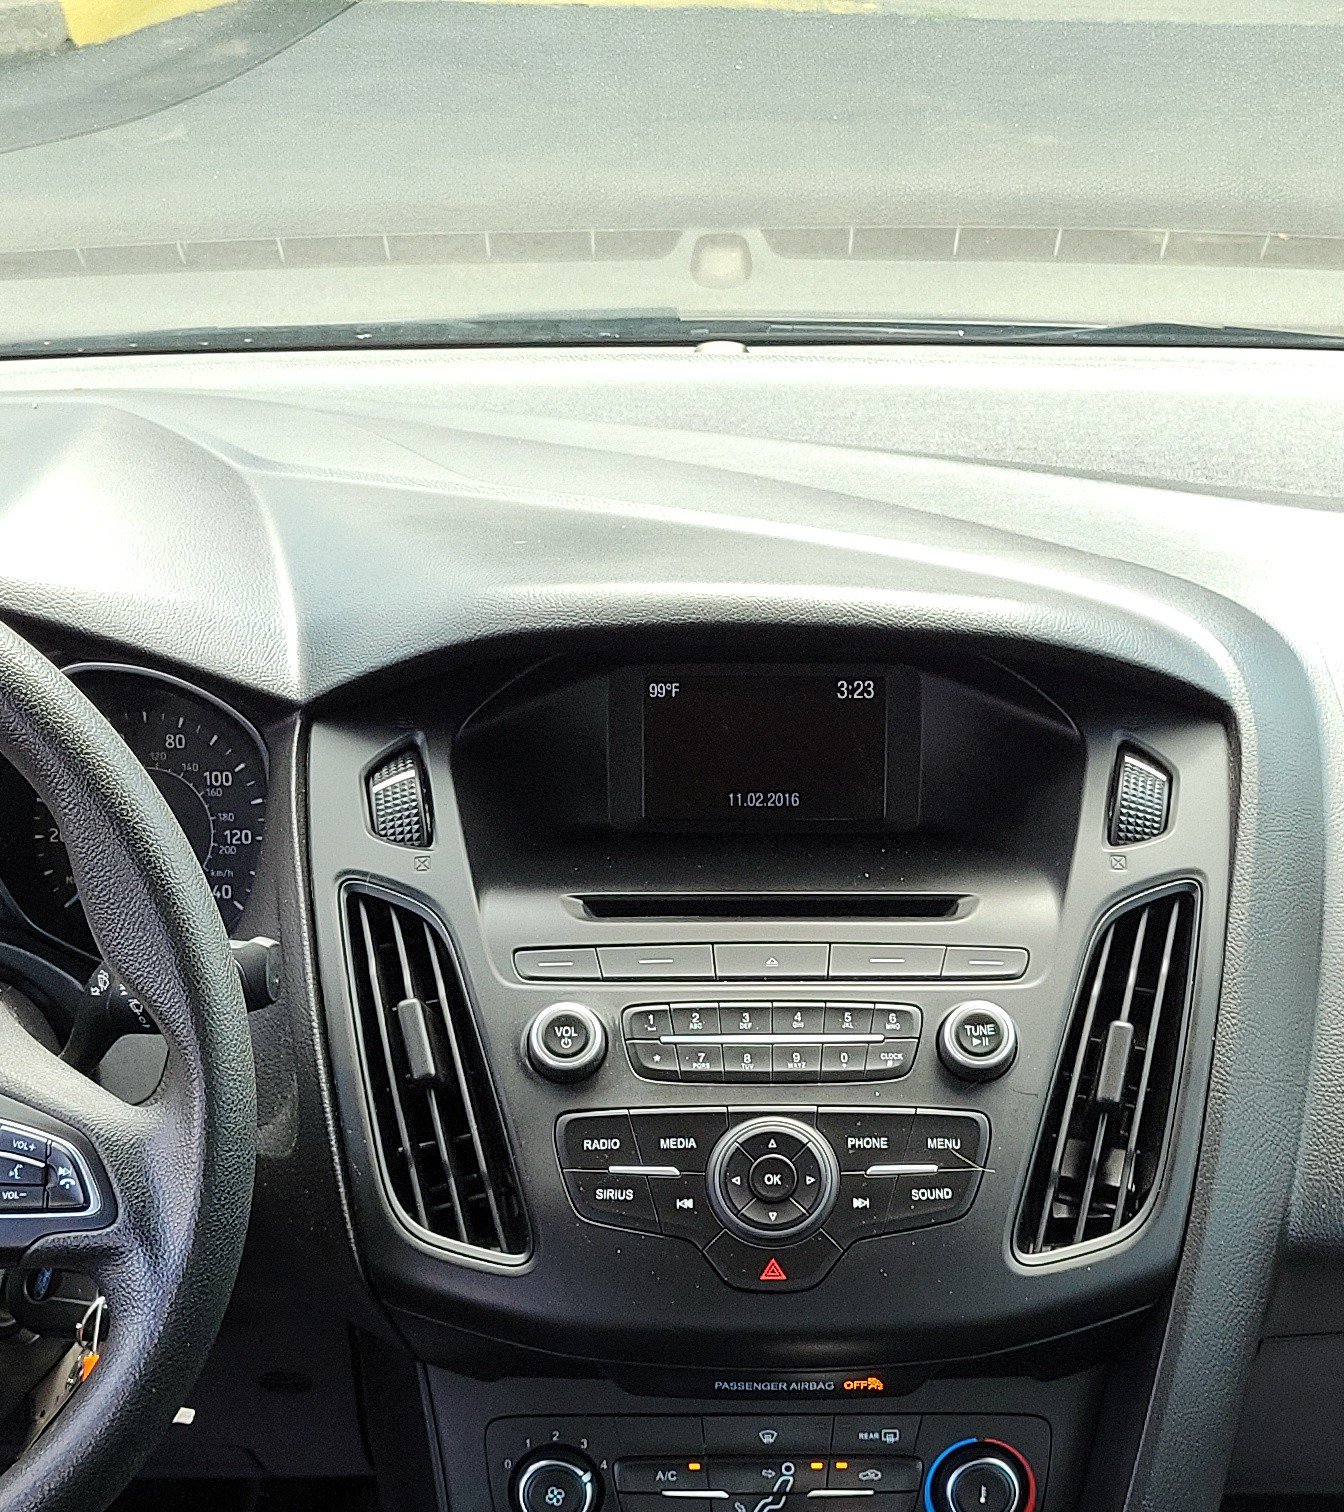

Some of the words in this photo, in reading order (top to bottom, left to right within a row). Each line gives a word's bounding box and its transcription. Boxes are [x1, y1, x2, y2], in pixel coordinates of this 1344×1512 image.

[649, 683, 679, 697] 99°F
[837, 680, 874, 699] 3:23
[165, 734, 185, 749] 80
[182, 763, 199, 772] 140
[204, 771, 232, 786] 100
[207, 788, 223, 797] 160
[728, 792, 800, 807] 11.02.2016
[218, 812, 234, 822] 180
[224, 830, 251, 845] 120
[219, 845, 237, 855] 200
[210, 868, 233, 878] km/h
[648, 1014, 654, 1024] 1
[692, 1013, 700, 1023] 2
[742, 1013, 750, 1023] 3
[794, 1012, 802, 1021] 4
[844, 1012, 852, 1022] 5
[889, 1013, 897, 1024] 6
[554, 1026, 578, 1037] VOL
[964, 1023, 996, 1036] TUNE
[697, 1052, 705, 1062] 7
[743, 1053, 751, 1063] 8
[792, 1052, 801, 1062] 9
[840, 1052, 848, 1062] 0
[583, 1138, 620, 1151] RADIO
[660, 1137, 696, 1150] MEDIA
[847, 1136, 888, 1149] PHONE
[927, 1137, 961, 1150] MENU
[764, 1173, 781, 1186] OK
[595, 1188, 634, 1201] SIRIUS
[911, 1187, 952, 1201] SOUND
[714, 1381, 787, 1391] PASSENGER
[789, 1381, 834, 1391] AIRBAG
[843, 1380, 868, 1390] OFF
[552, 1431, 559, 1441] 2
[858, 1432, 879, 1440] REAR
[525, 1438, 531, 1448] 1
[580, 1439, 588, 1449] 3
[504, 1459, 512, 1468] 0
[600, 1460, 608, 1470] 4
[656, 1470, 677, 1481] A/C
